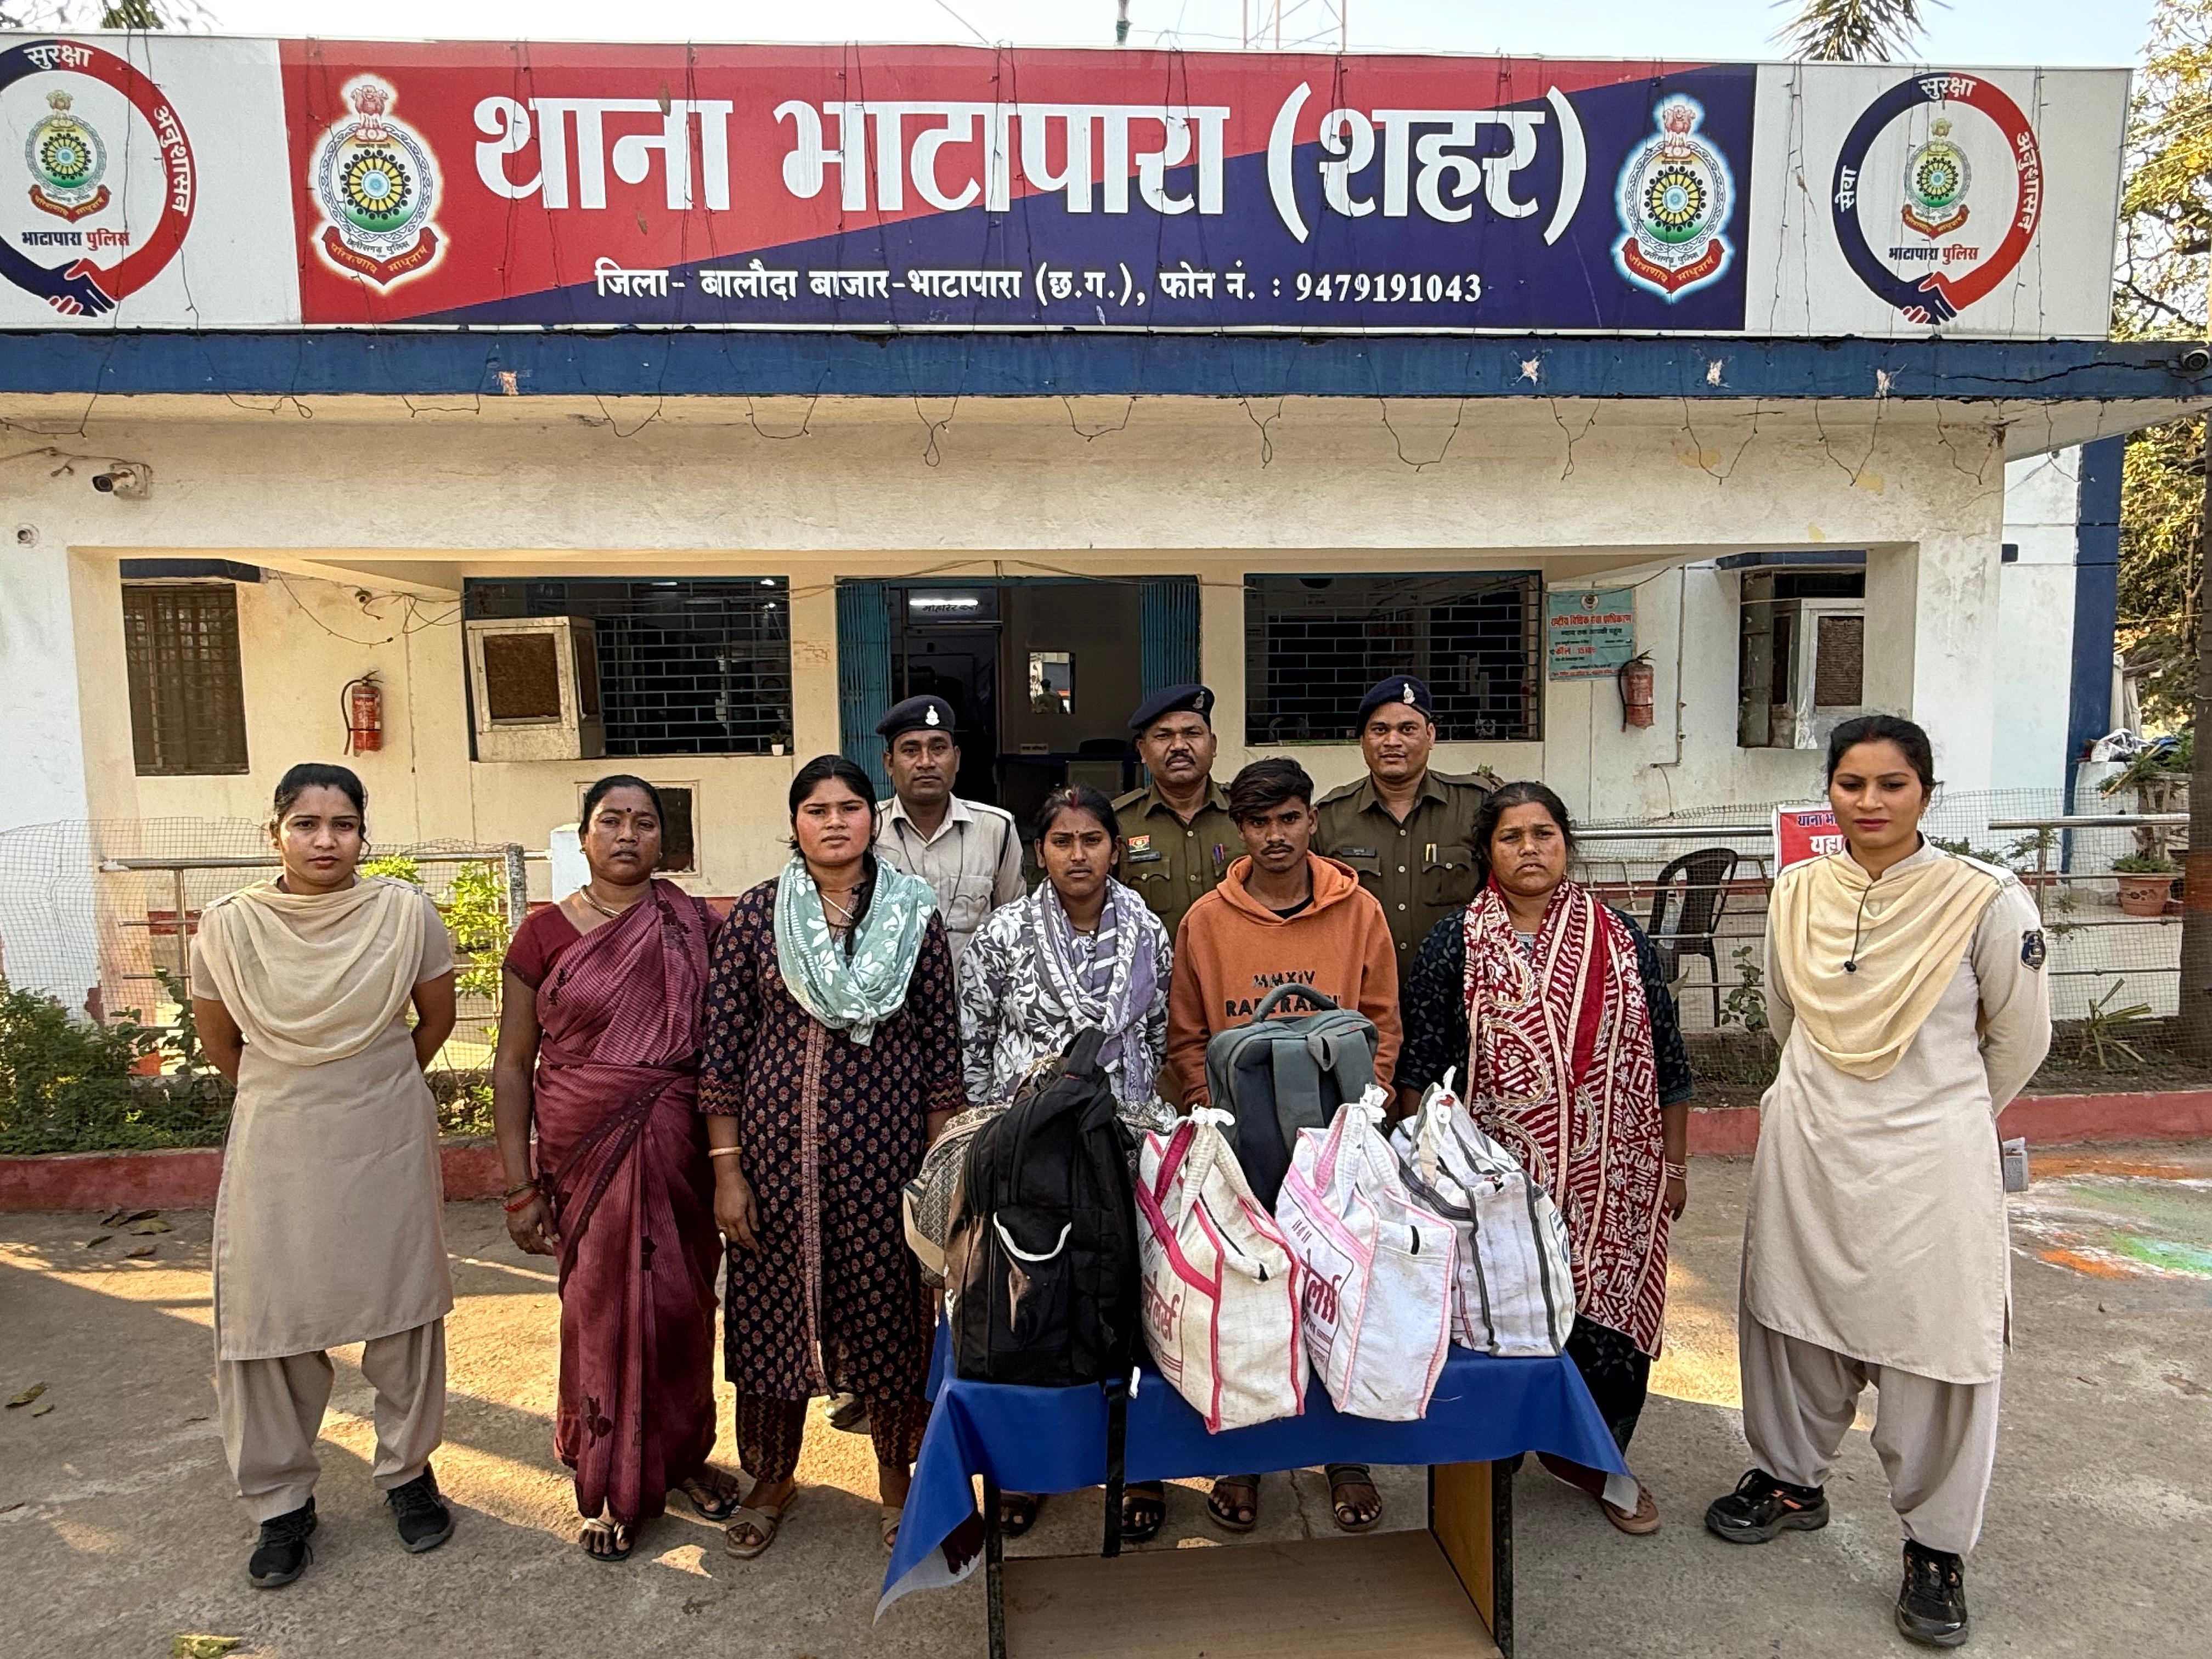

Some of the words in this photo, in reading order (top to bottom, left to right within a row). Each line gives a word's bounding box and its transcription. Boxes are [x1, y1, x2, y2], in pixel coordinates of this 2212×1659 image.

[23, 44, 94, 69] सुरक्षा
[1918, 77, 1977, 99] सुरक्षा
[154, 105, 191, 217] अनुशासन
[473, 95, 733, 211] थाना
[773, 99, 1231, 215] भाटापारा
[1268, 81, 1588, 246] (शहर)
[1835, 166, 1857, 213] सेवा
[2017, 132, 2039, 234] अनुशासन
[22, 231, 82, 246] भाटापारा
[86, 228, 129, 251] पुलिस
[1889, 247, 1939, 261] भाटापारा
[1943, 244, 1979, 264] पुलिस
[699, 258, 798, 301] बालौदा
[1159, 261, 1216, 300] फोन
[1226, 260, 1255, 300] नं.
[1296, 273, 1481, 302] 9479191043
[1798, 815, 1822, 826] थाना
[1253, 970, 1315, 988] MMXIV
